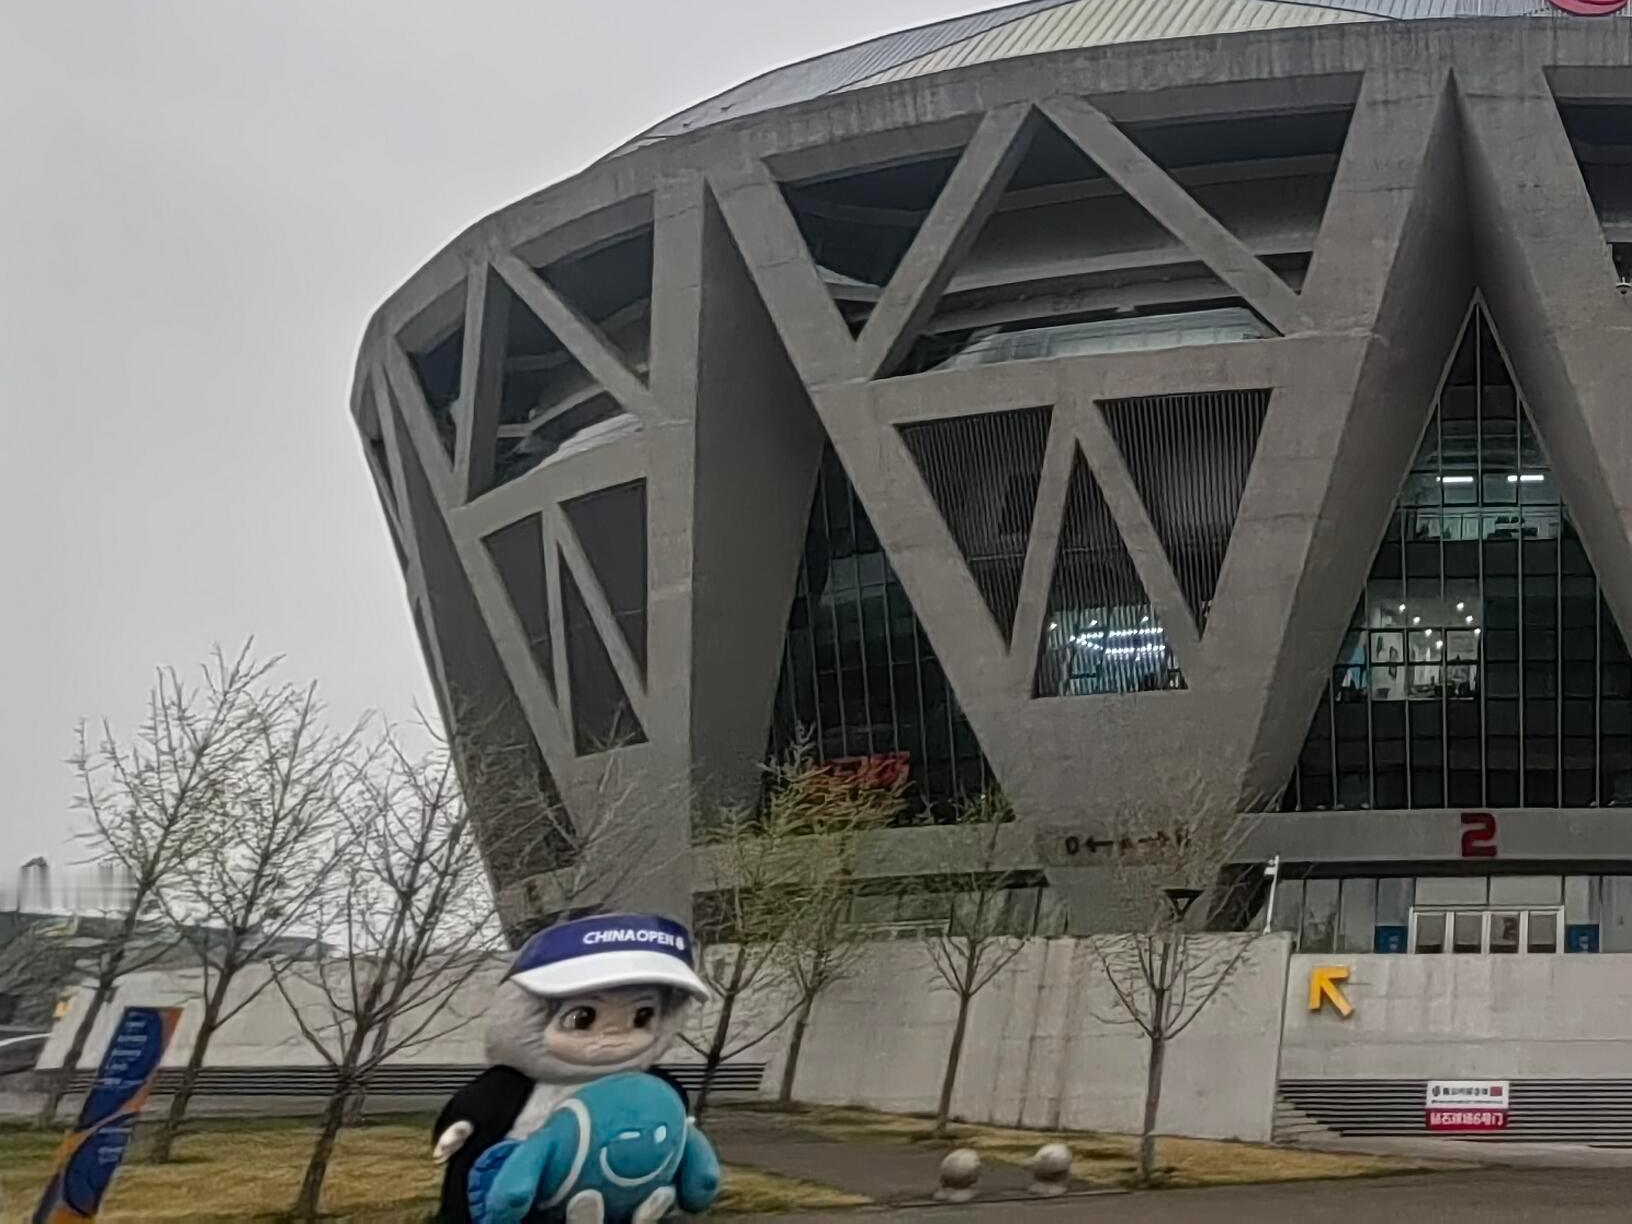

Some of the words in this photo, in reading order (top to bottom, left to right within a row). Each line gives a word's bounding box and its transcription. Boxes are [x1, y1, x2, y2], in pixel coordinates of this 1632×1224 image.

[1461, 812, 1497, 857] 2
[582, 929, 635, 945] CHINA
[636, 930, 674, 947] OPEN
